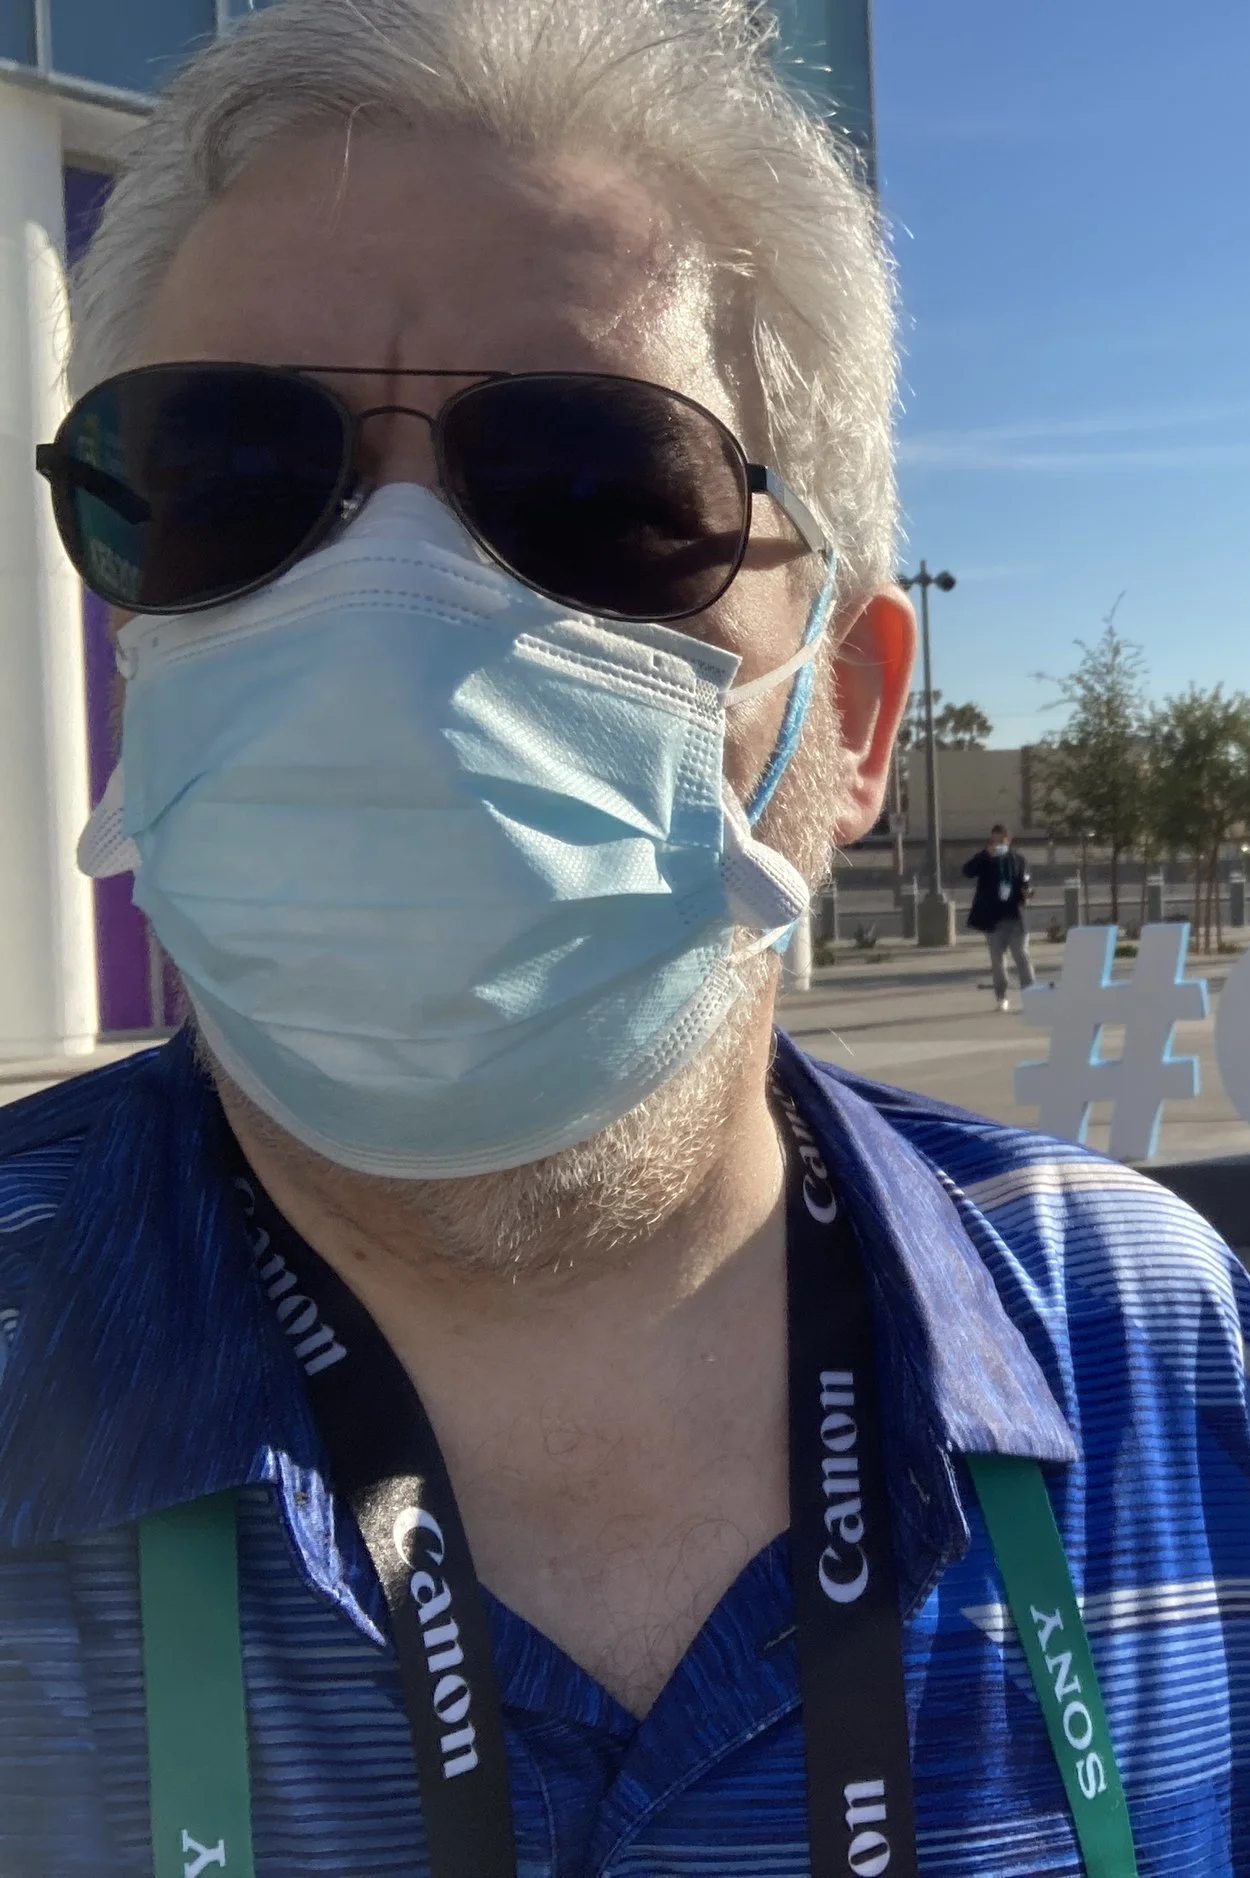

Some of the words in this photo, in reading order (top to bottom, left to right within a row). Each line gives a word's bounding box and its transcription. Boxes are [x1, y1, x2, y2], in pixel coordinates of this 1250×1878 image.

[820, 1369, 869, 1605] Canon
[394, 1507, 484, 1780] Canon
[1031, 1605, 1108, 1801] SONY
